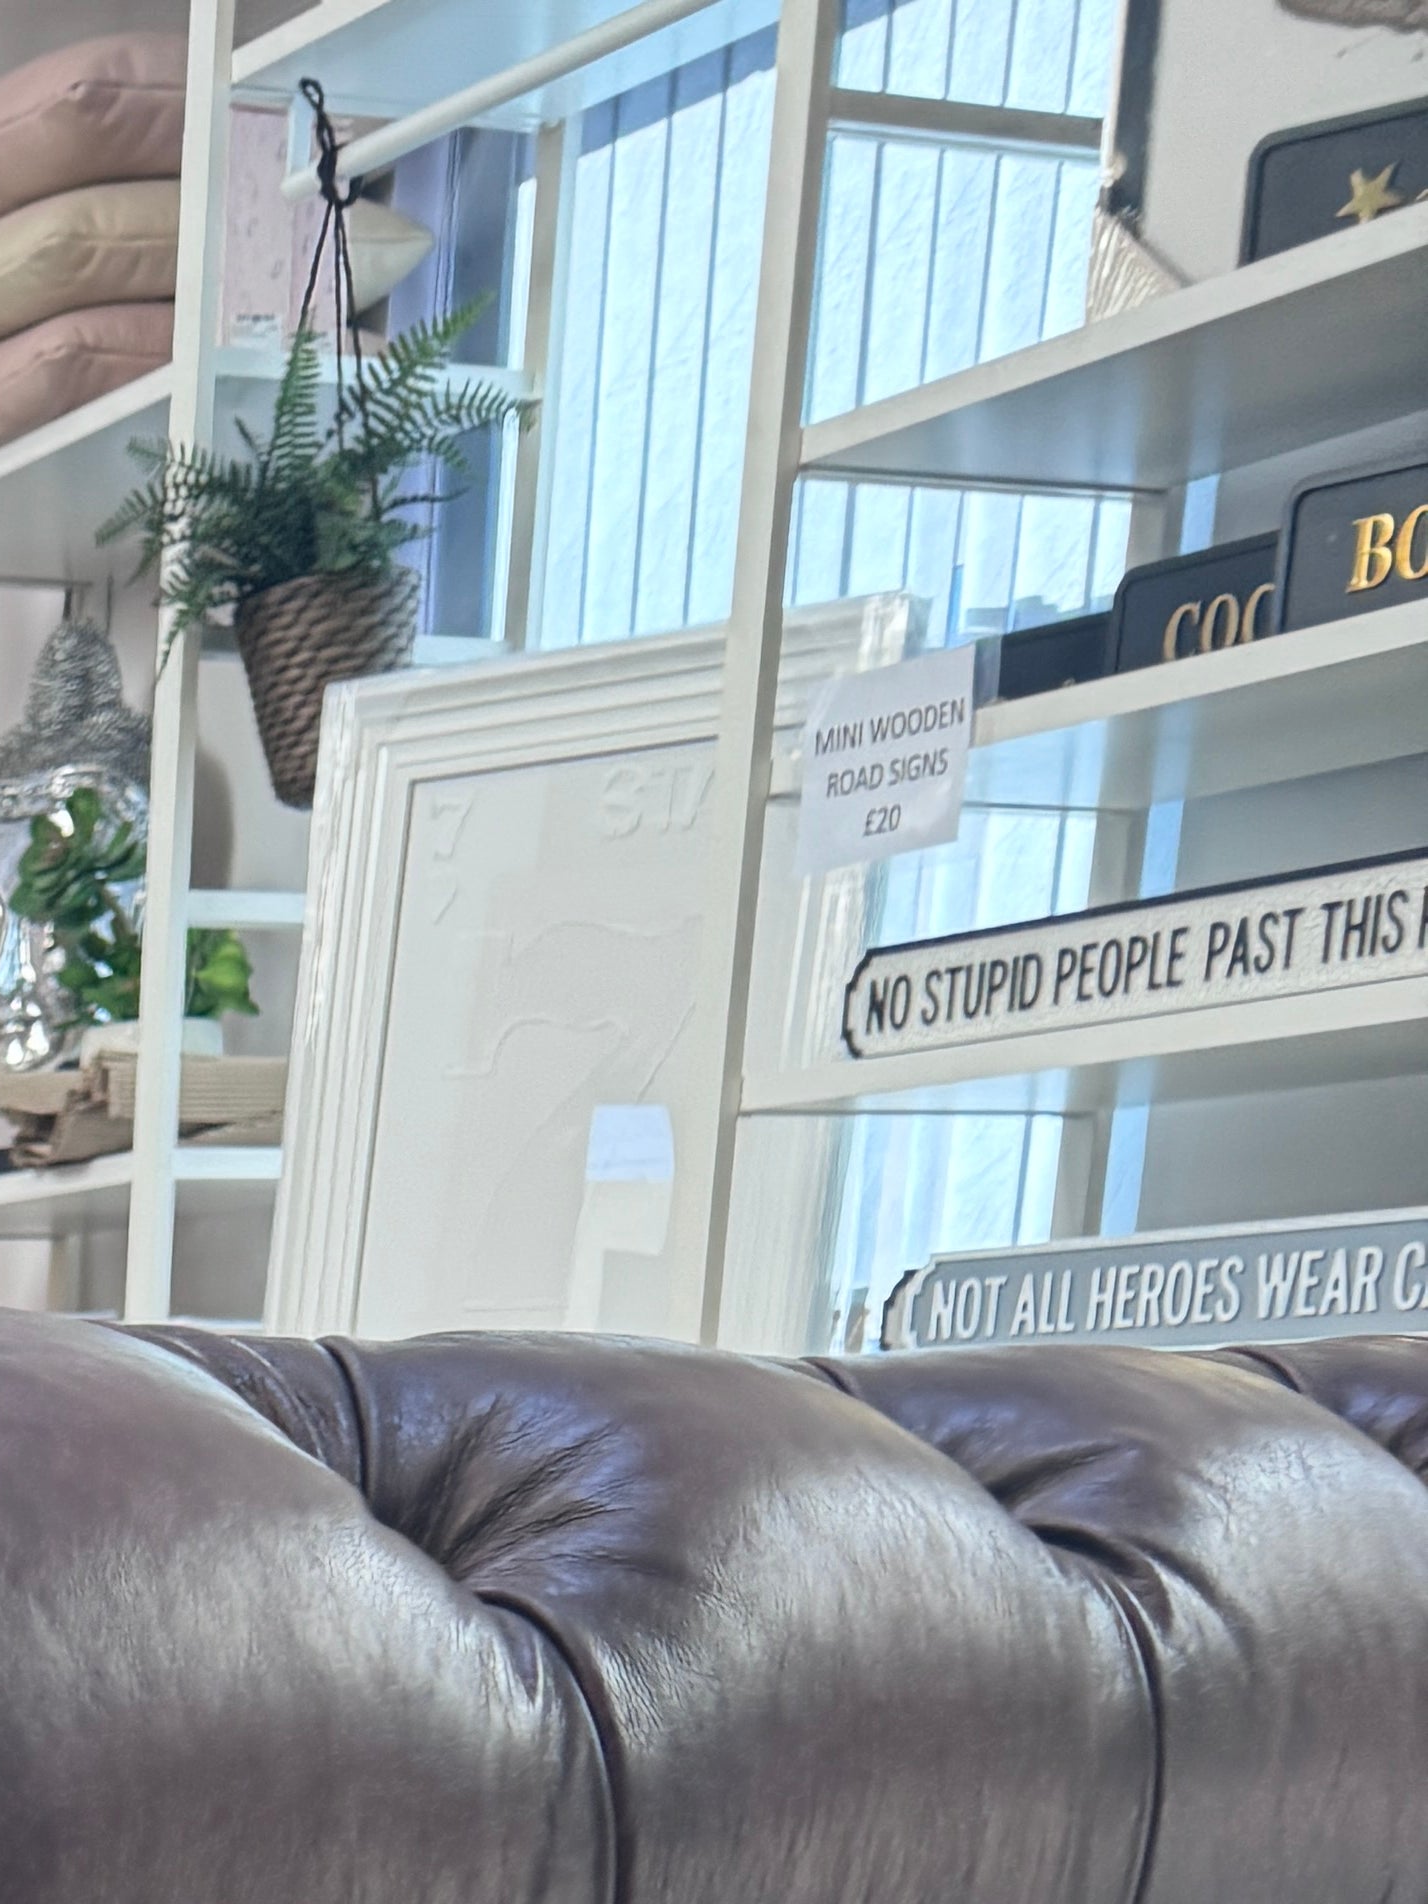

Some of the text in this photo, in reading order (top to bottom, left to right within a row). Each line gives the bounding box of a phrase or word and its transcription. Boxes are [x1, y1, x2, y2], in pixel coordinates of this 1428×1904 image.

[815, 698, 964, 757] MINI WOODEN
[827, 748, 949, 798] ROAD SIGNS
[863, 804, 901, 837] £20
[866, 974, 910, 1035] NO
[921, 953, 1042, 1027] STUPID
[1053, 926, 1190, 1008] PEOPLE
[1204, 907, 1307, 982] PAST
[1321, 889, 1410, 963] THIS
[928, 1241, 1428, 1342] NOT ALL HEROES WEAR C
